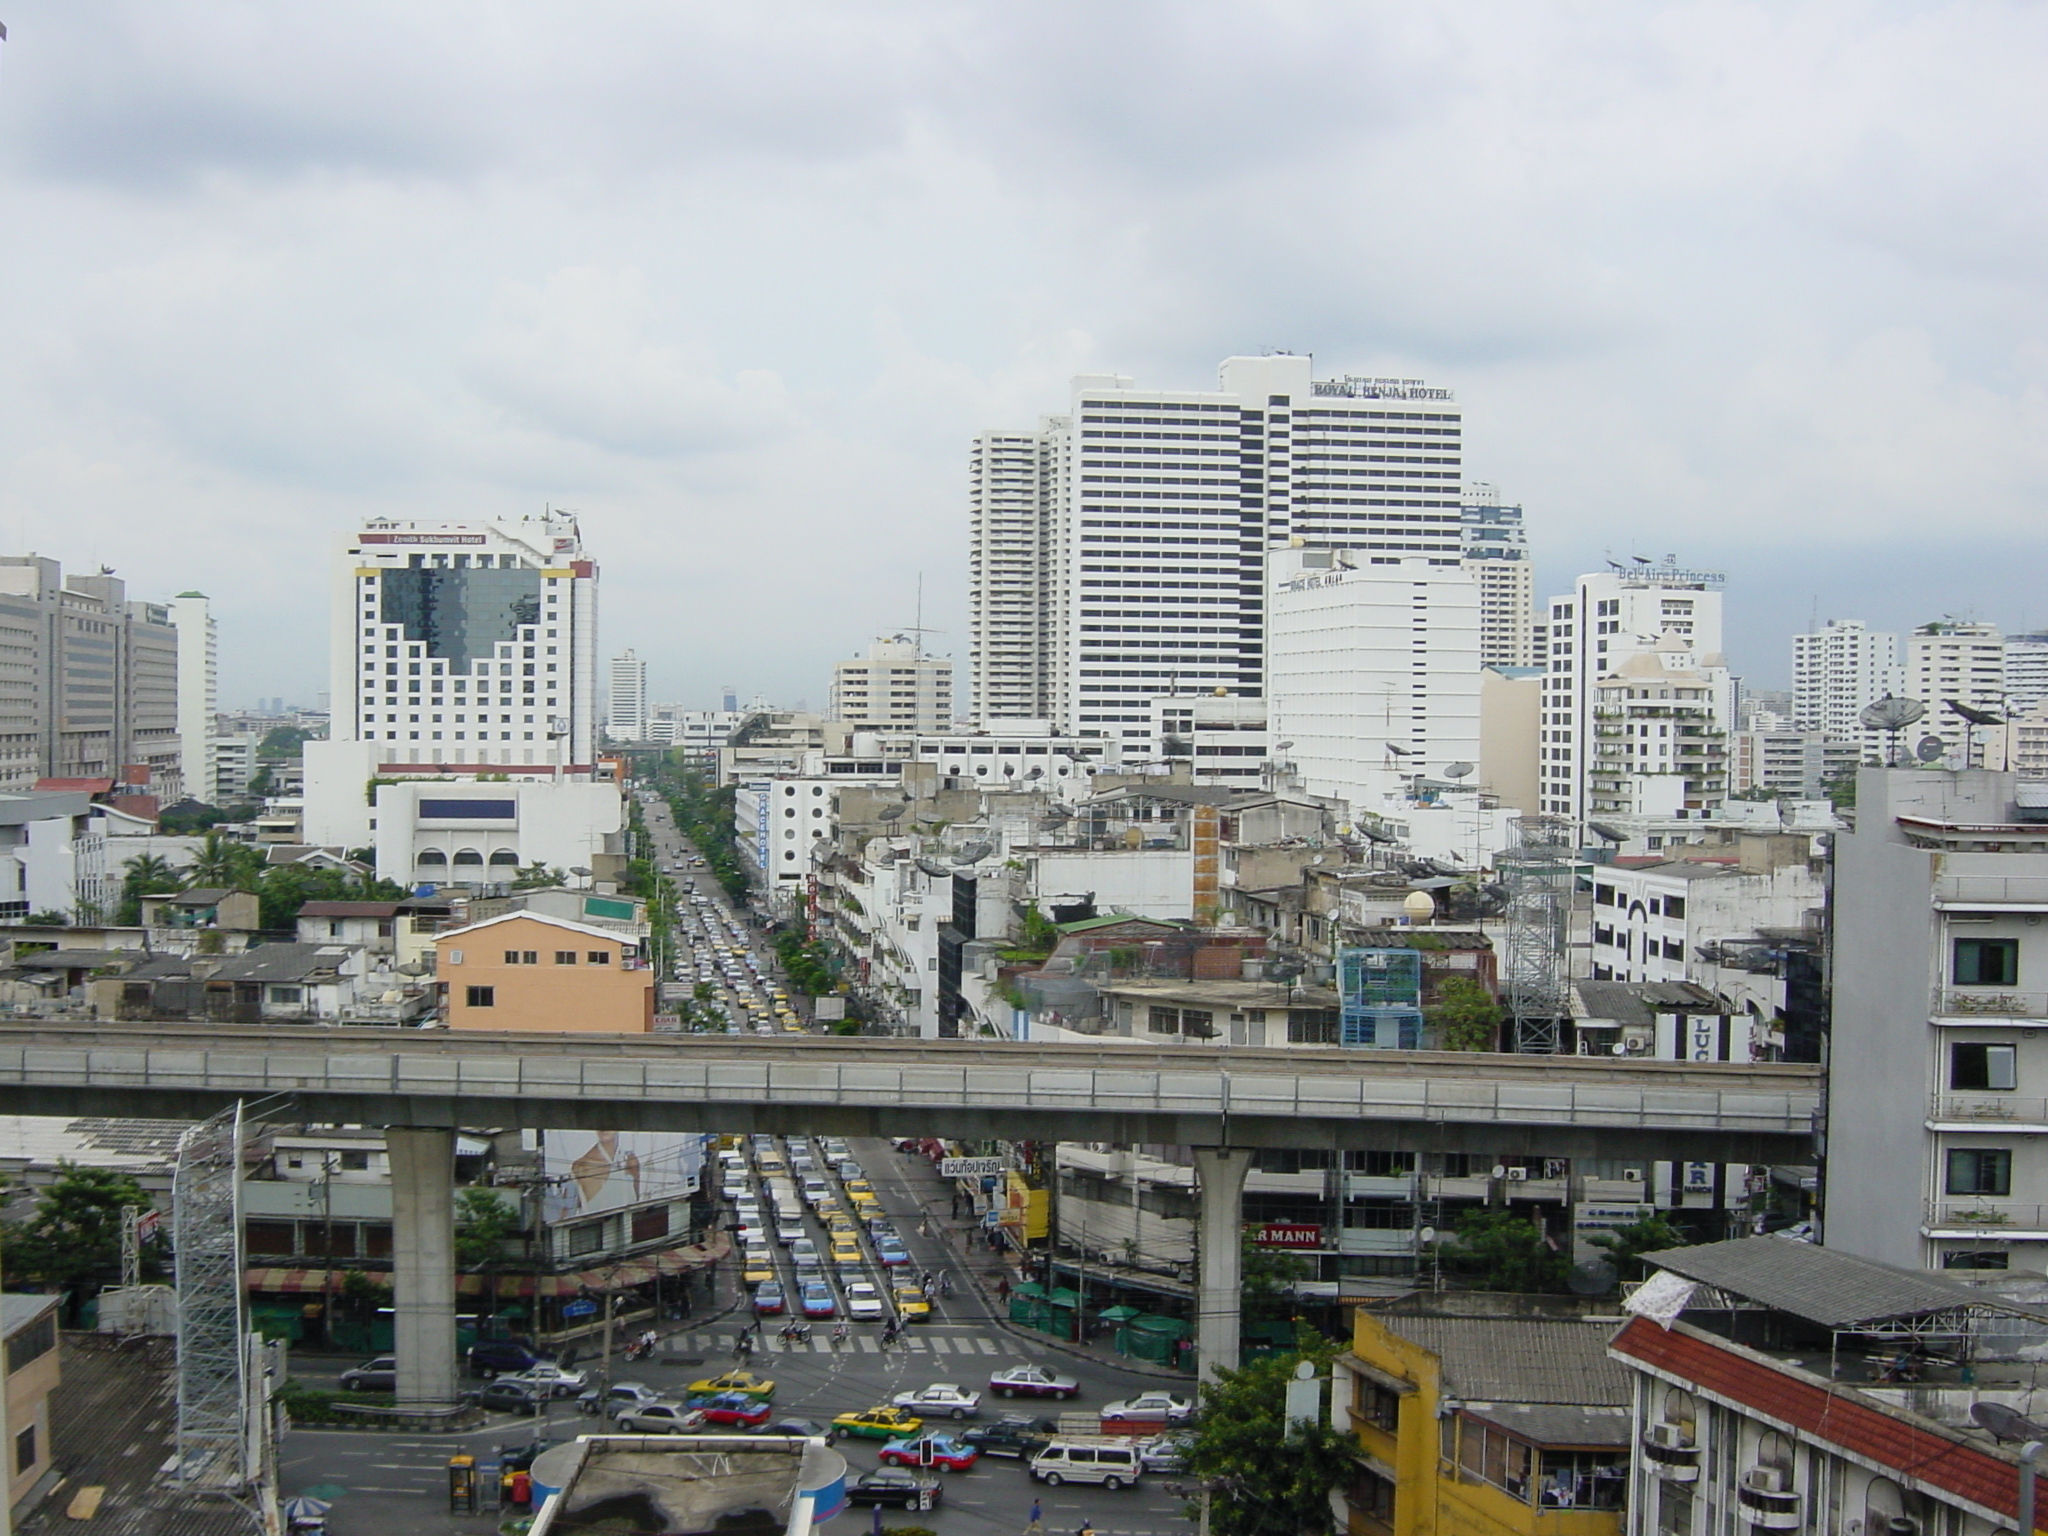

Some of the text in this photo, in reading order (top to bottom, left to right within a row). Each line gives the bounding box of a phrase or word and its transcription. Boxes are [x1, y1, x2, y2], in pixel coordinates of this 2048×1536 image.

[1409, 387, 1451, 400] HOTEL
[393, 535, 482, 544] Zenith Sukhumvit Hotel
[1672, 568, 1726, 582] Princess
[759, 793, 767, 830] GRACE
[759, 832, 767, 869] HOTEL
[1270, 1229, 1316, 1243] MANN
